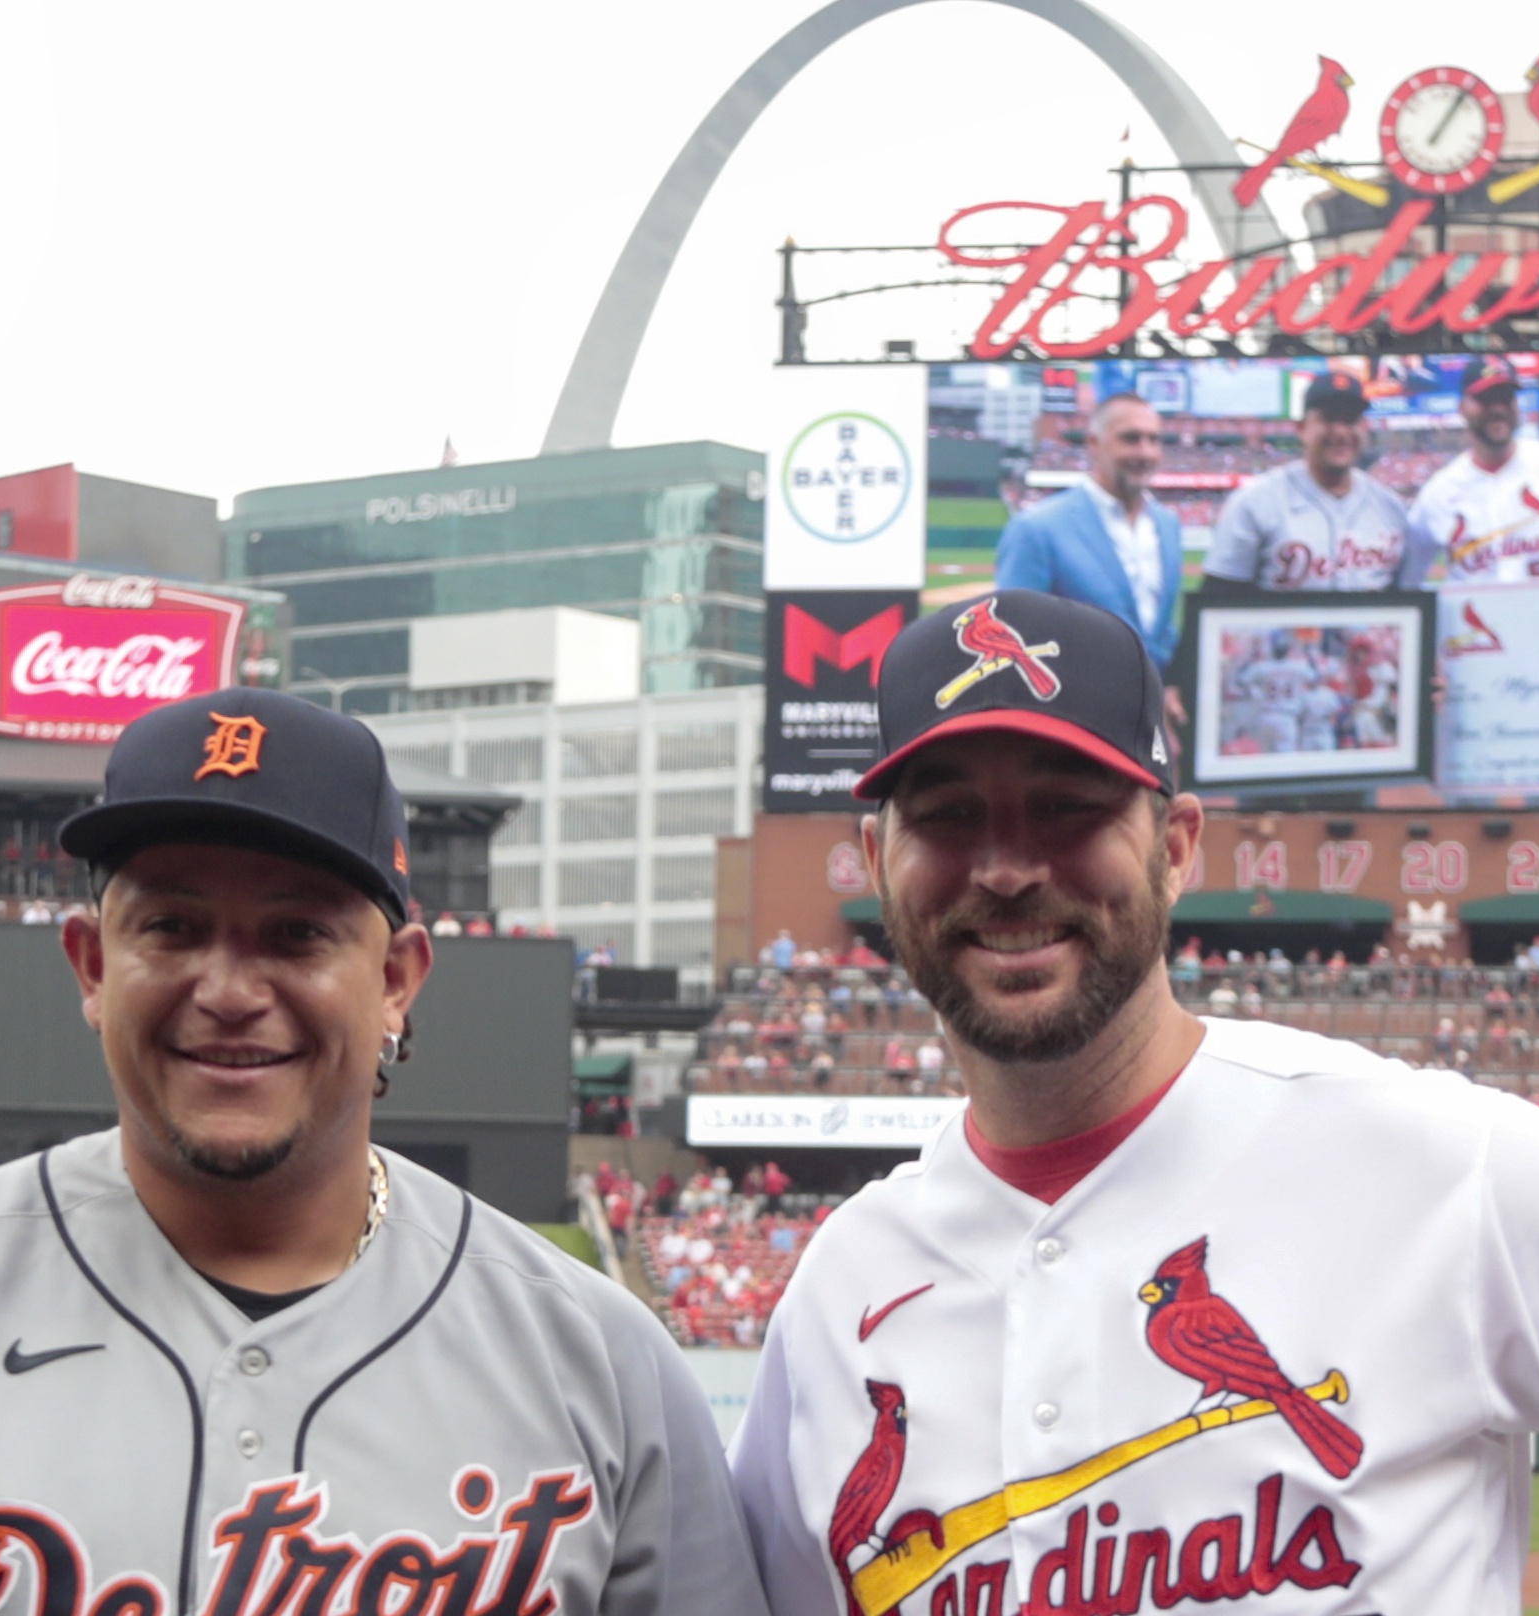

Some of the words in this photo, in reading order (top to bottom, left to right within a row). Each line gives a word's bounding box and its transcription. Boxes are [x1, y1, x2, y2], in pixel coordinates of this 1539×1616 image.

[794, 466, 899, 487] BAYER
[367, 487, 516, 526] POLSINELLI
[1319, 841, 1372, 893] 17
[1401, 841, 1468, 894] 20
